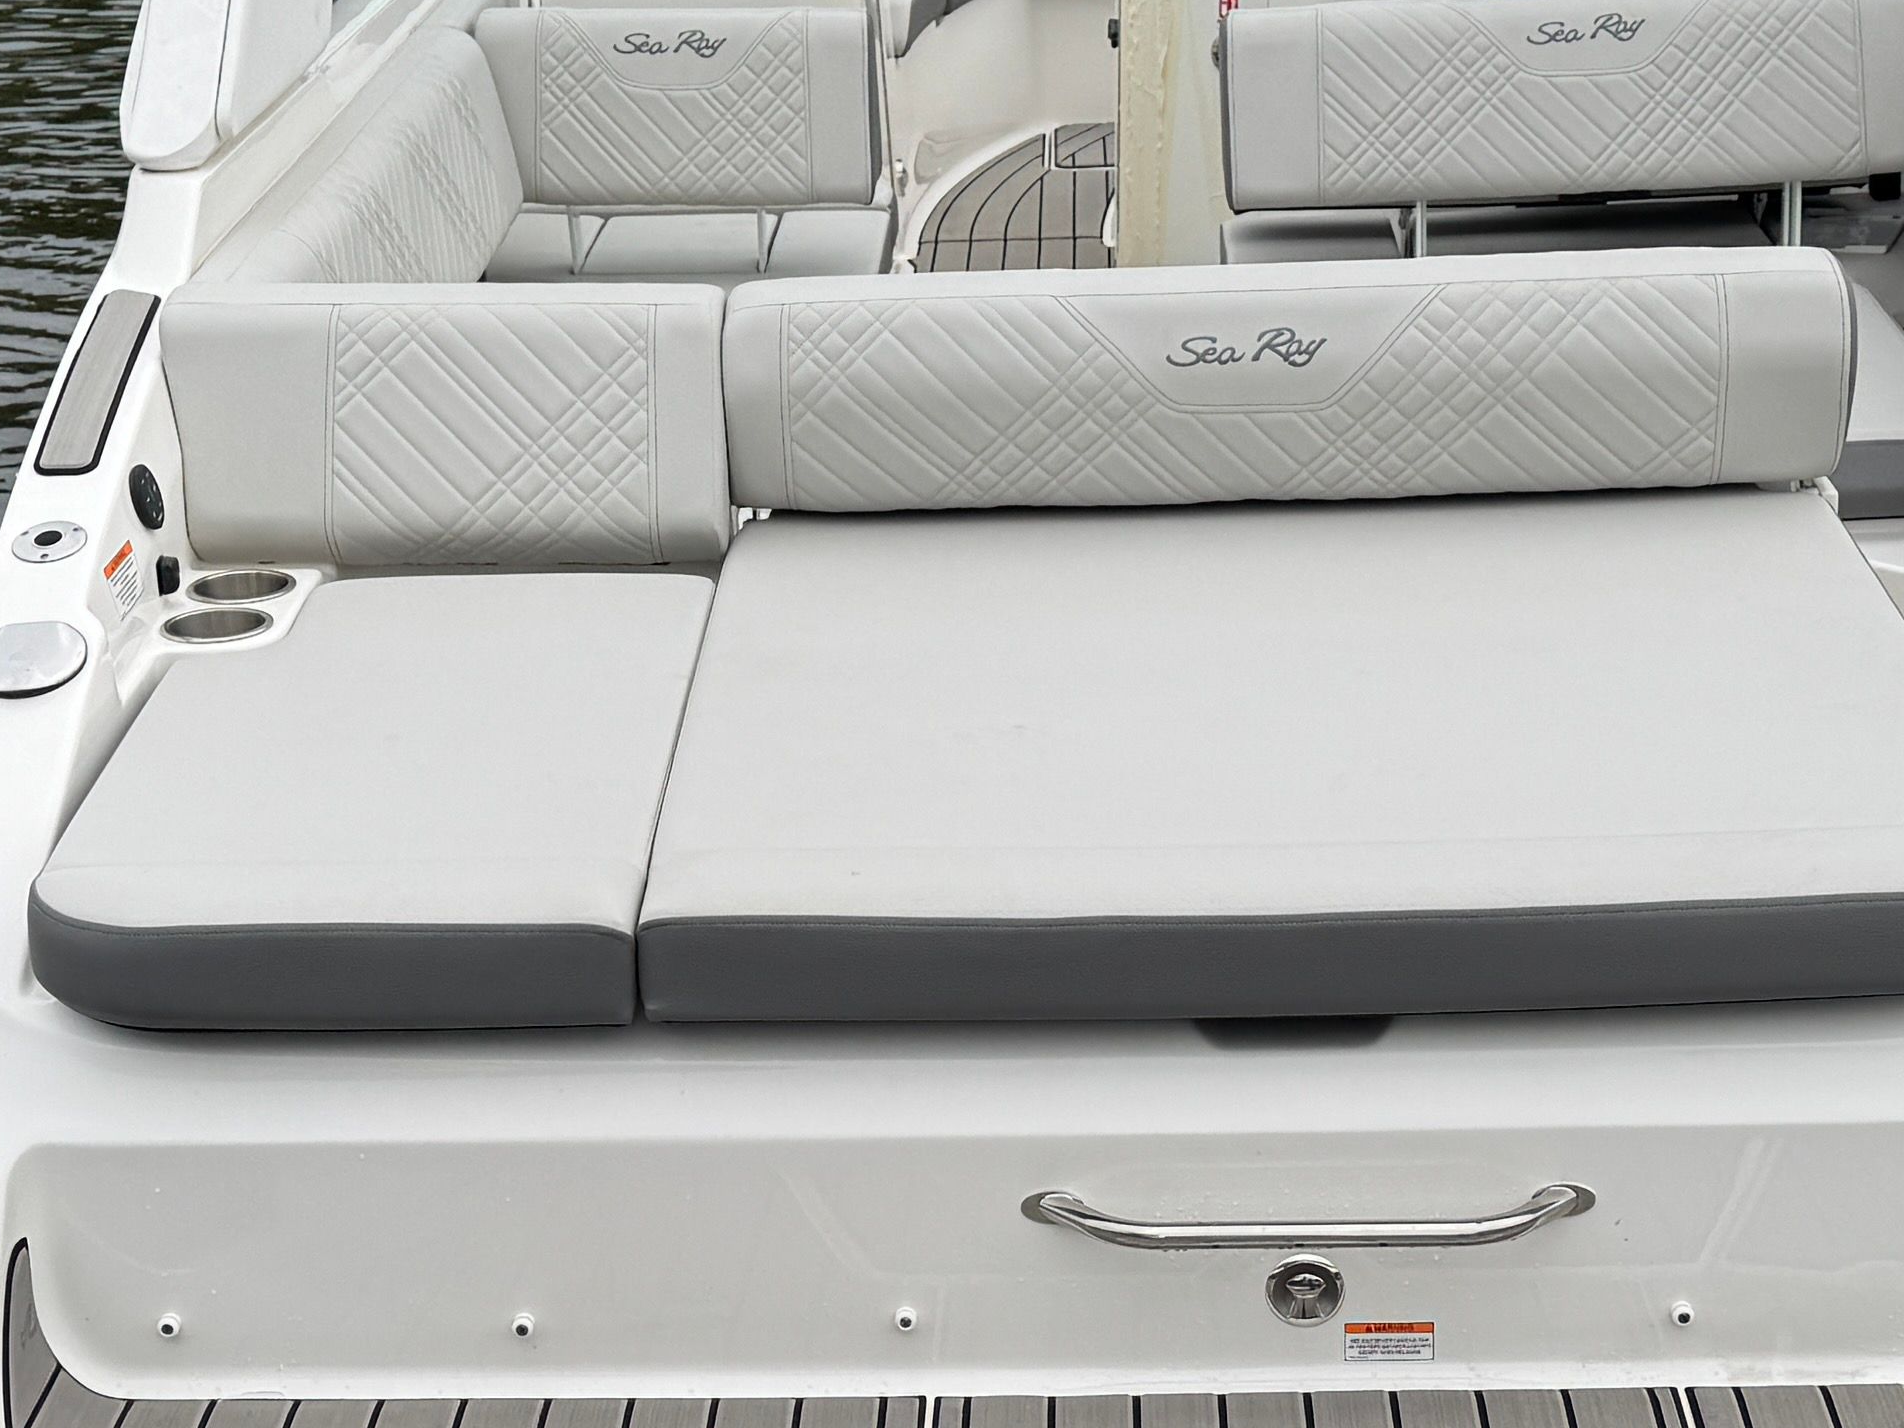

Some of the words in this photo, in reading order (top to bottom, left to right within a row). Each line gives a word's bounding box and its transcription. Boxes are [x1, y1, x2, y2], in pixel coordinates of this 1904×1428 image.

[613, 33, 670, 55] Sea
[673, 30, 727, 58] Ray
[1527, 22, 1586, 45] Sea
[1589, 12, 1646, 42] Ray
[1166, 336, 1246, 367] Sea
[1251, 327, 1328, 368] Ray
